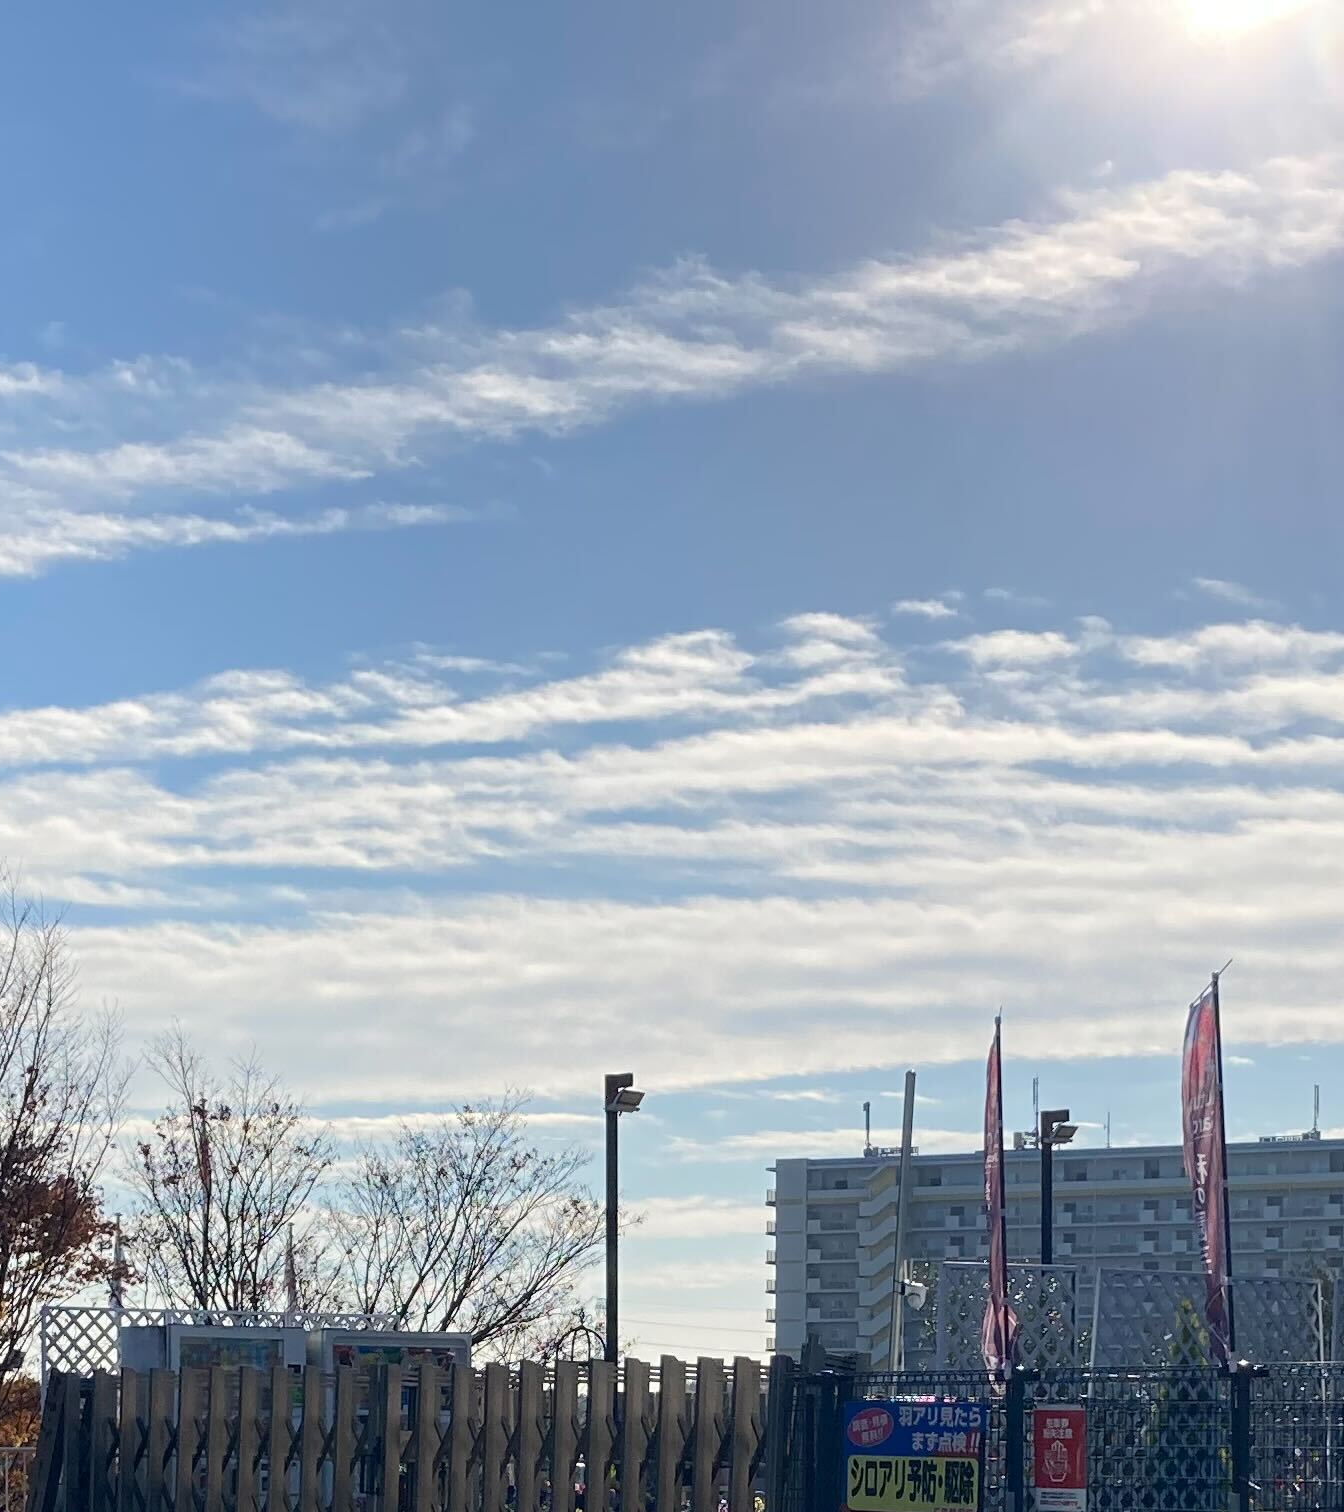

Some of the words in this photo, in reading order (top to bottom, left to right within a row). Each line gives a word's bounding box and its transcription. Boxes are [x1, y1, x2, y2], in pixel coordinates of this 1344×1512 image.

[898, 1406, 982, 1428] 羽アリ見たら
[911, 1432, 981, 1453] まず点検!!
[850, 1458, 974, 1505] シロアリ予防・駆除
